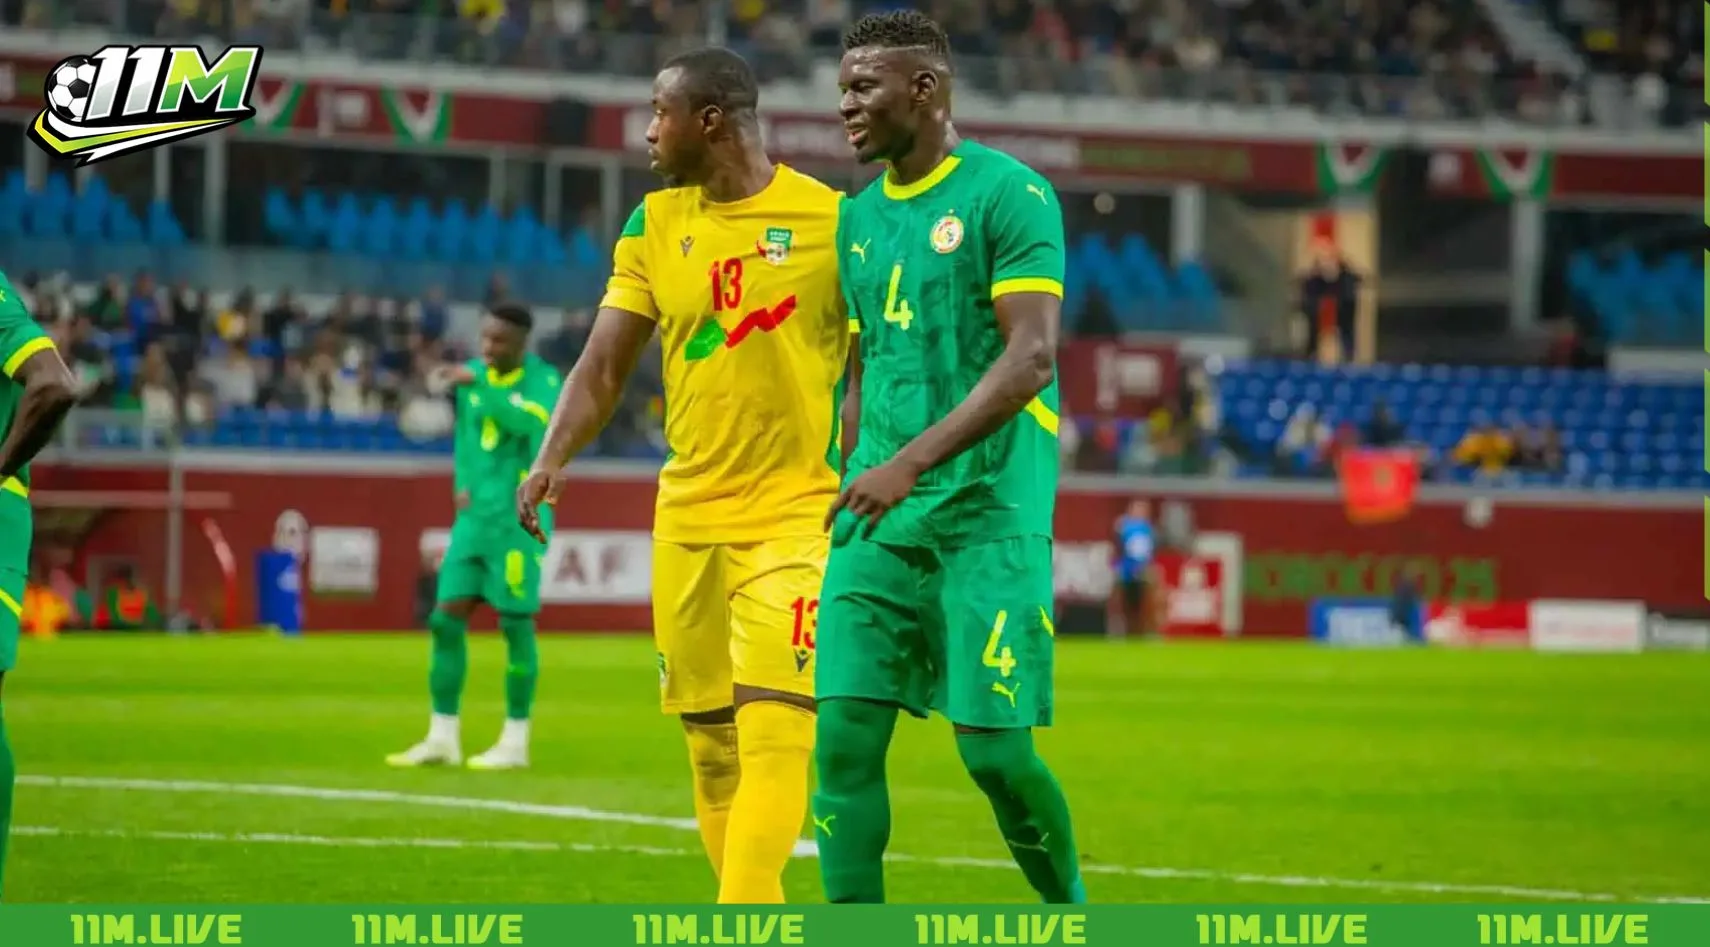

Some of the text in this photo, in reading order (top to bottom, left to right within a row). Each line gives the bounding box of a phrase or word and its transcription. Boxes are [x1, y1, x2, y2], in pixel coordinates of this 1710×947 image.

[709, 257, 743, 312] 13
[884, 263, 914, 330] 4
[982, 609, 1017, 677] 4
